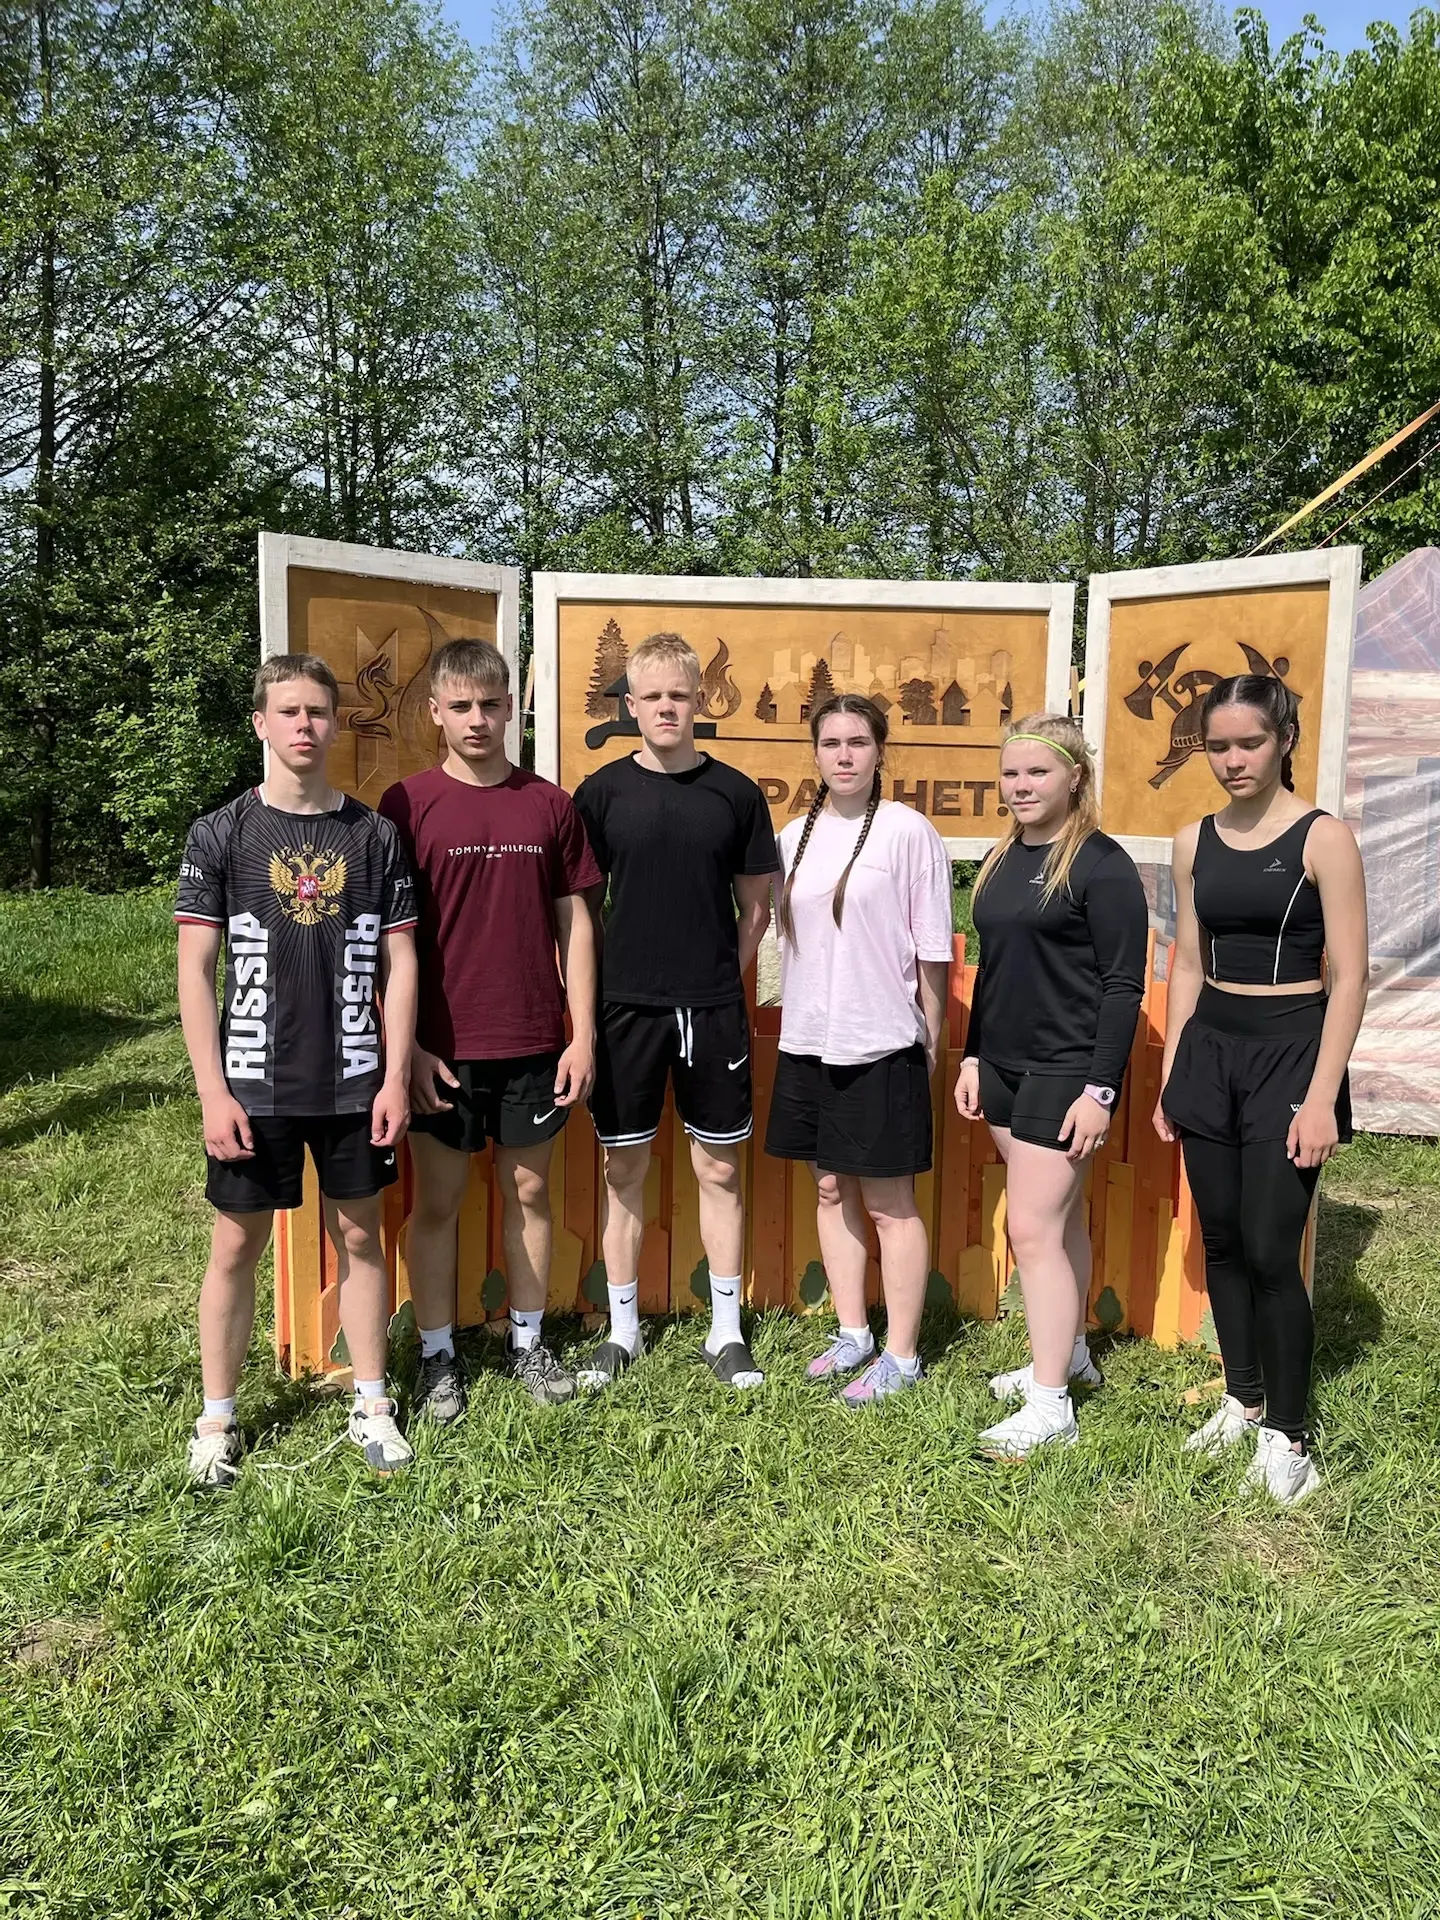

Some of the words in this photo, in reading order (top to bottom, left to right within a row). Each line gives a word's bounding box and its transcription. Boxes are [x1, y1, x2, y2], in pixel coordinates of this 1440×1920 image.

[448, 845, 487, 856] TOMMY
[500, 844, 544, 854] HILFIGER
[225, 912, 269, 1080] RUSSIA
[341, 913, 381, 1080] RUSSIA
